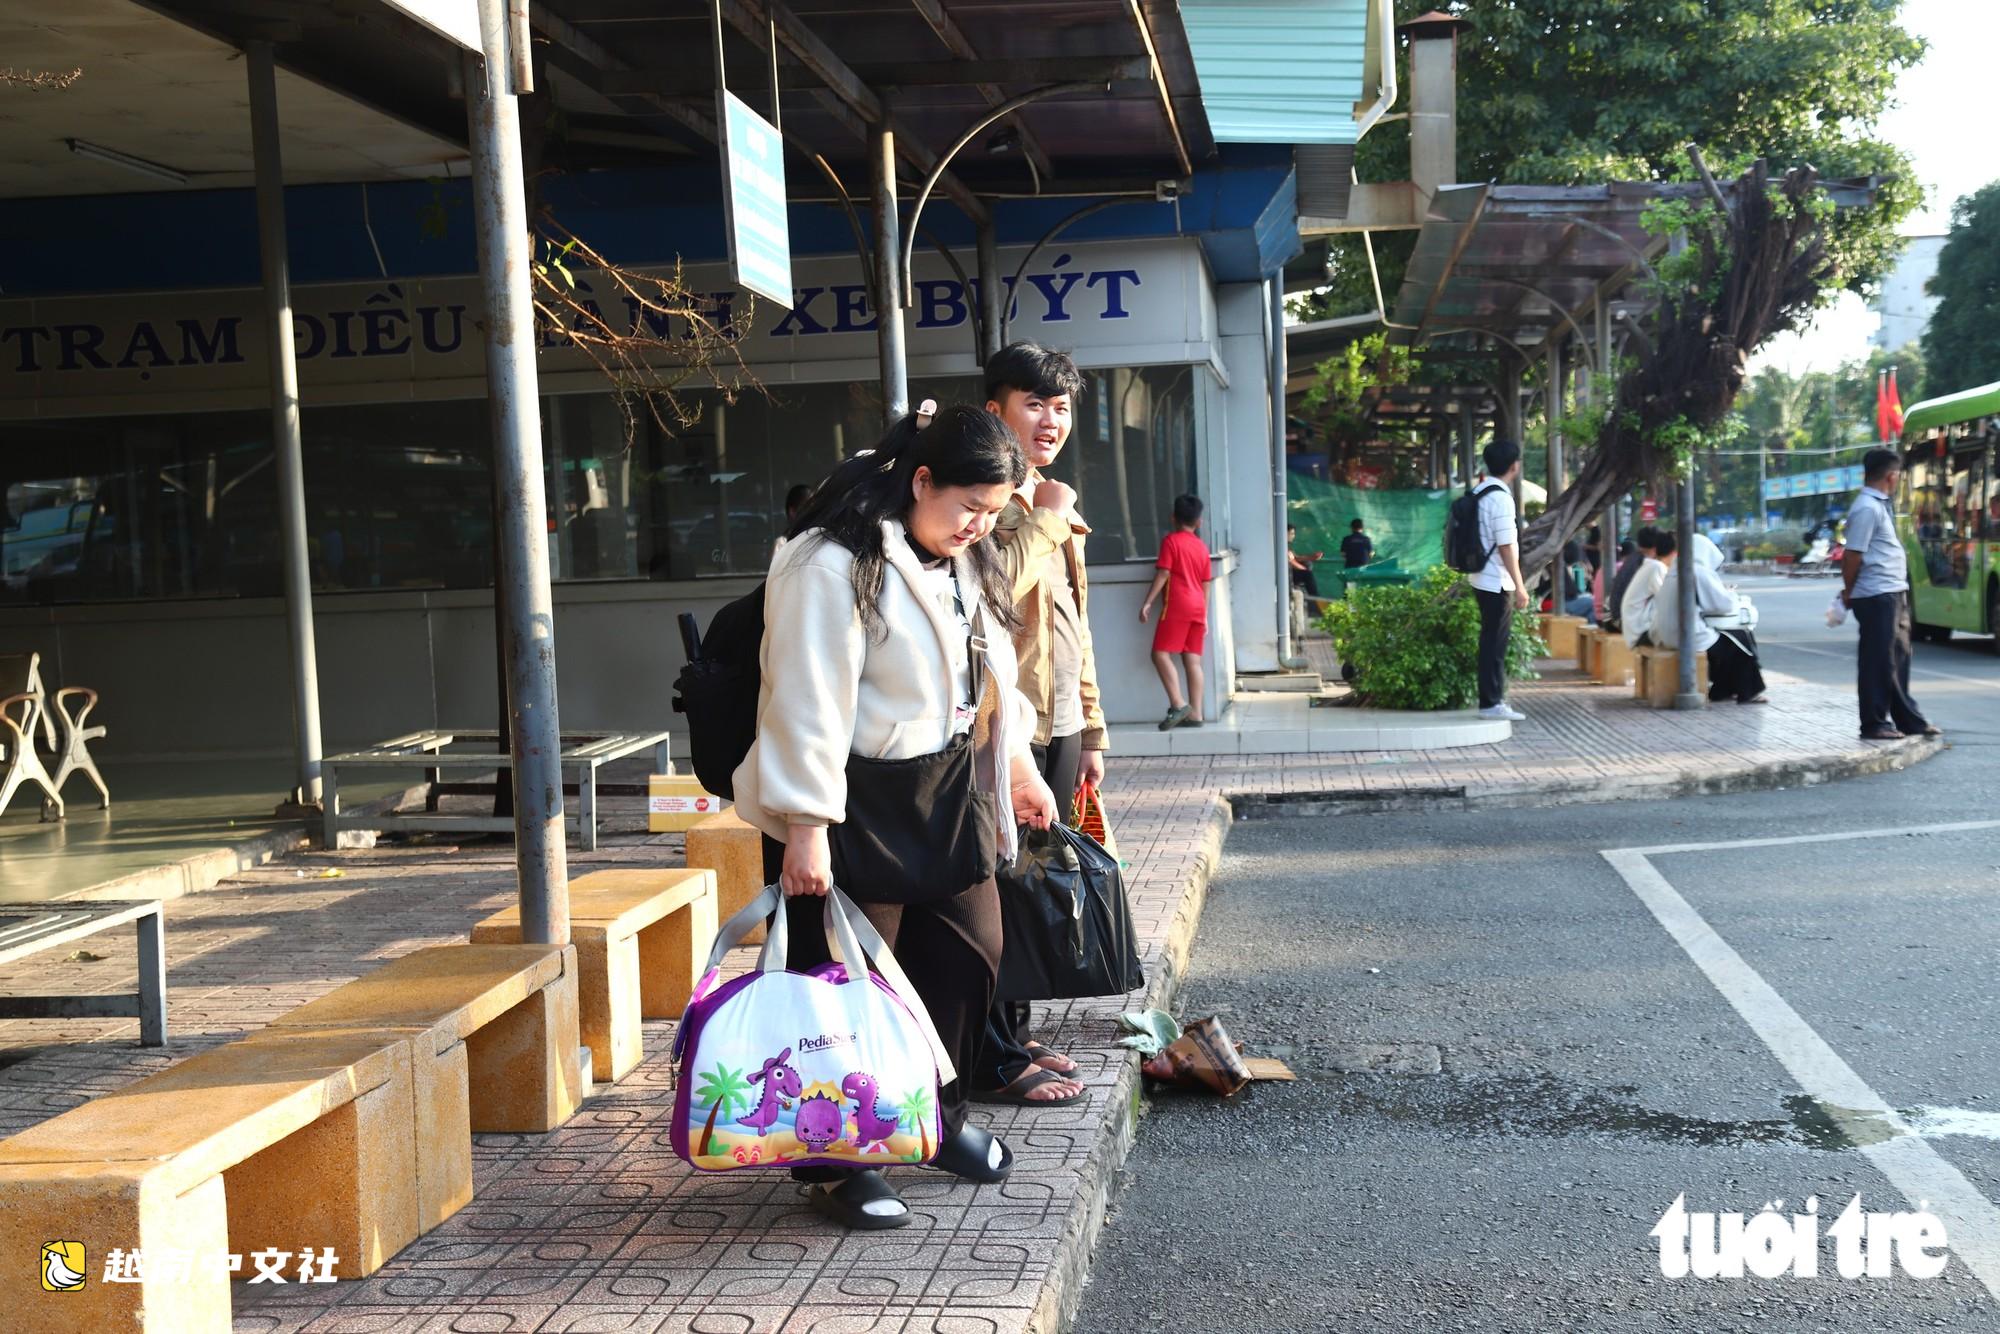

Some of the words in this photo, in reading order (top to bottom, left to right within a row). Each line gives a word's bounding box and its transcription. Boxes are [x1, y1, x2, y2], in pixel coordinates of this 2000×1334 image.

[2, 317, 244, 381] TRẠM
[770, 285, 878, 337] XE
[799, 1033, 857, 1052] PediaSue
